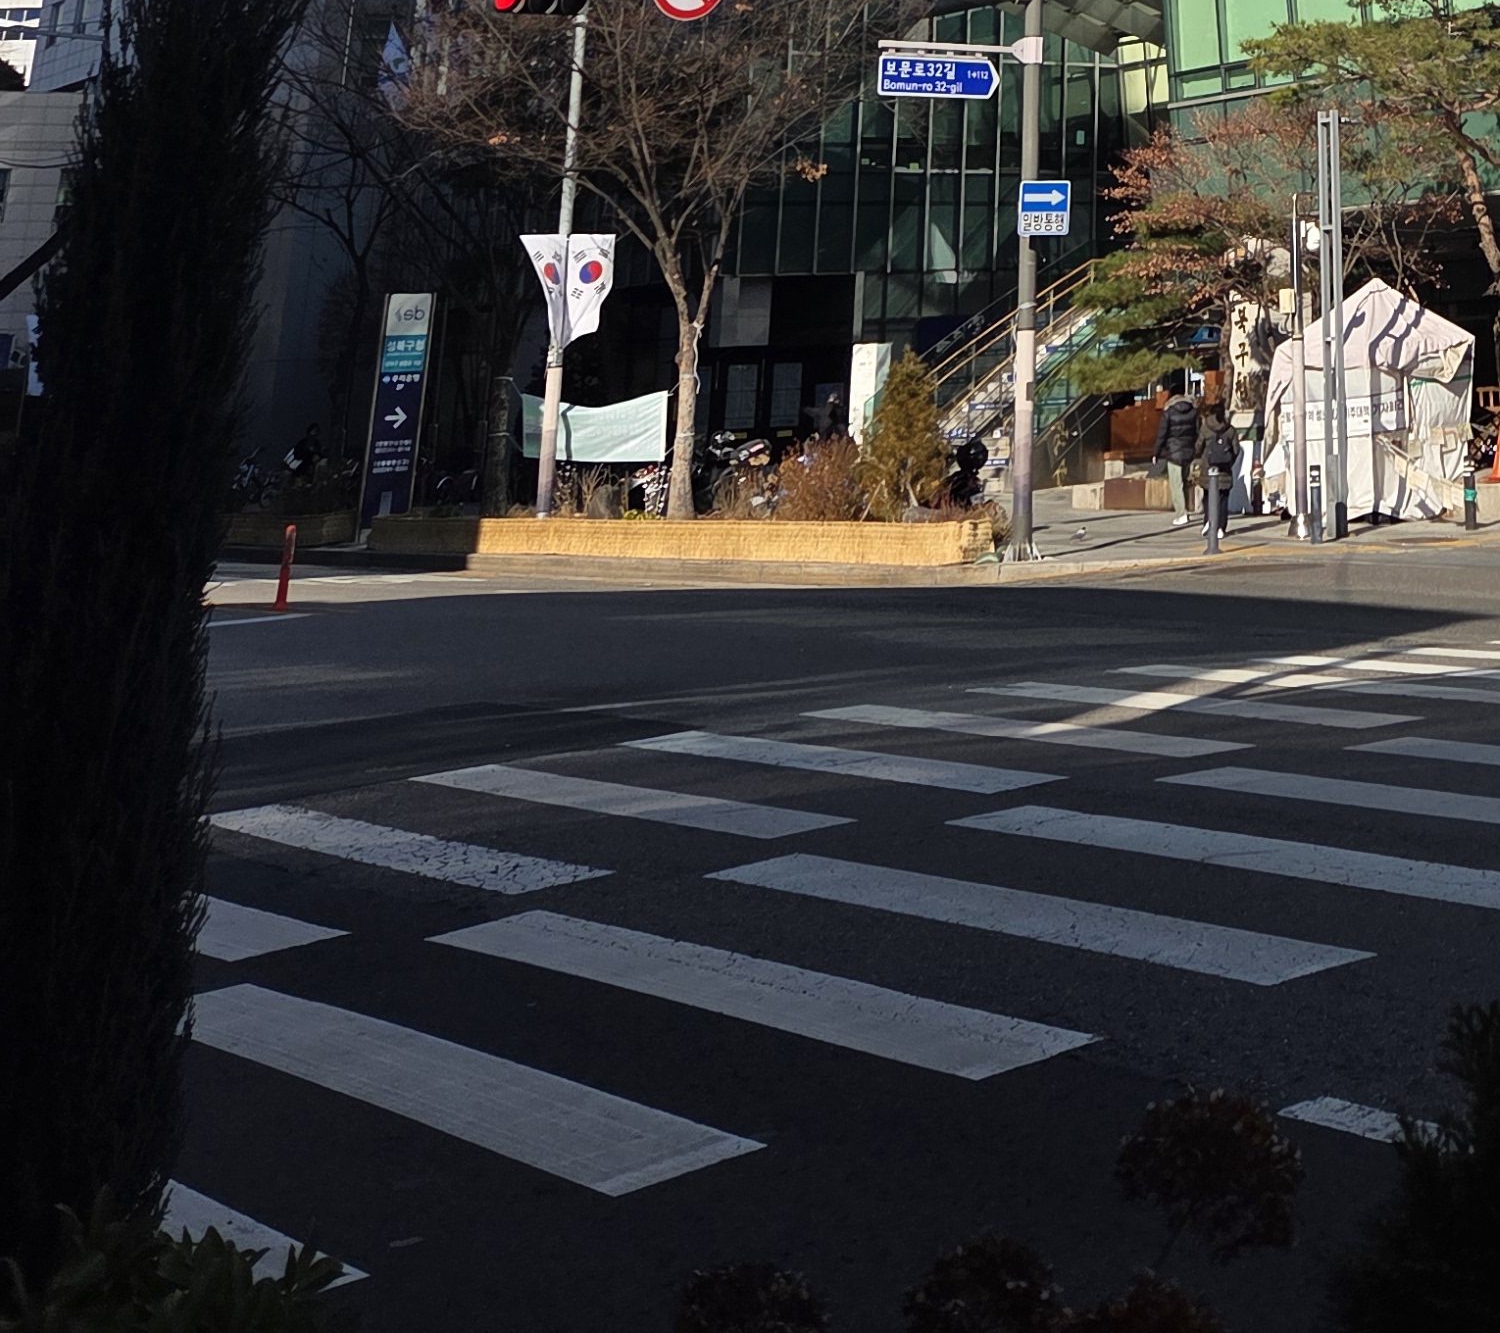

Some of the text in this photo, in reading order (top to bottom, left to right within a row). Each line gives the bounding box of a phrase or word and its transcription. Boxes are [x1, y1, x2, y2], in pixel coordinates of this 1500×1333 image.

[884, 62, 956, 80] 보문로32길
[883, 79, 963, 94] Bomun-ro 32-gil
[1022, 213, 1065, 232] 일방통행
